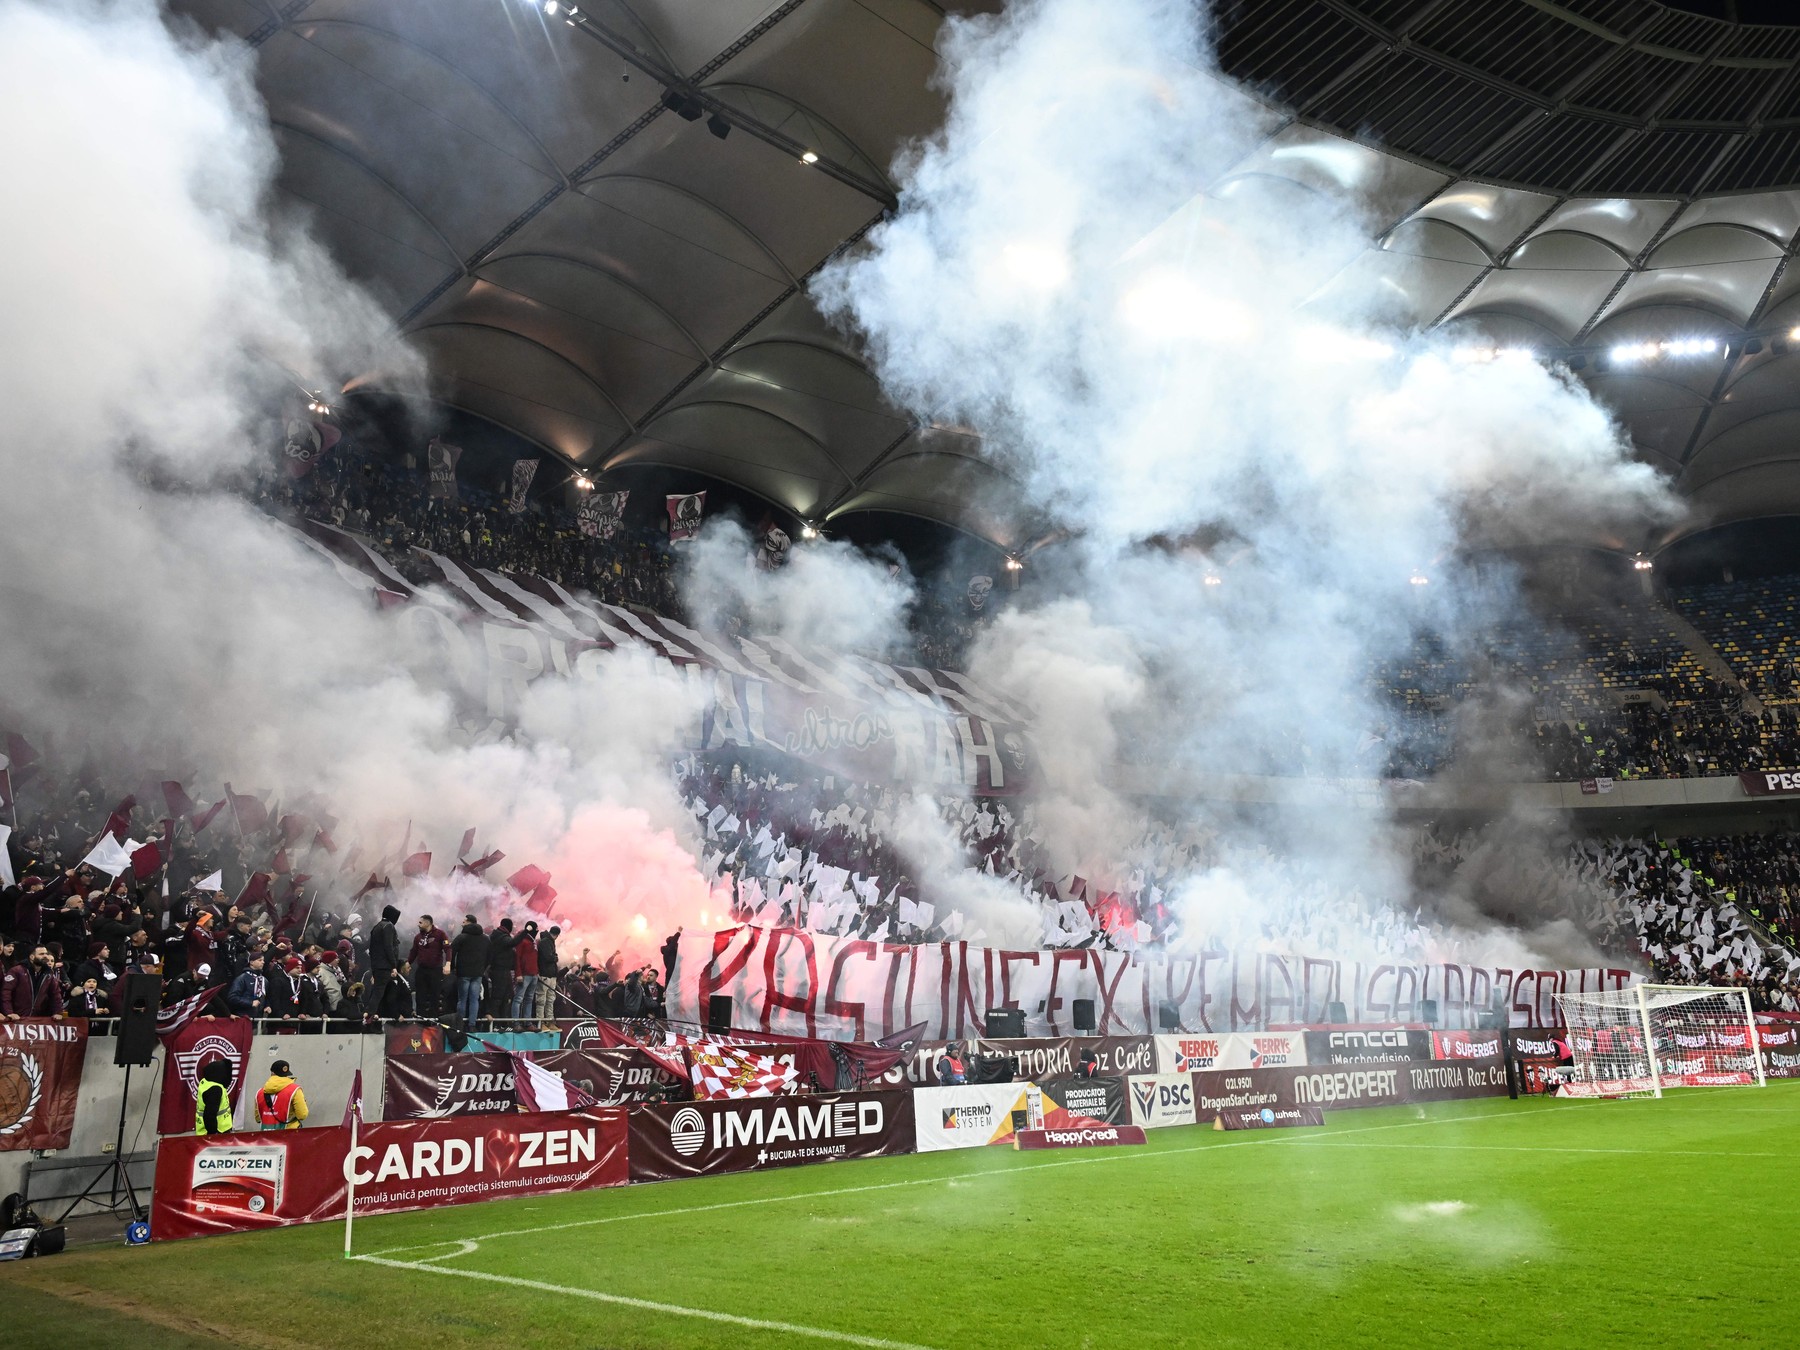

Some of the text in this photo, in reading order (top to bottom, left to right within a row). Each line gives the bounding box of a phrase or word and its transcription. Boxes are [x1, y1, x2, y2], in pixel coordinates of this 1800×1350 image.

[4, 1024, 78, 1045] VIȘINIE
[1718, 1032, 1746, 1047] SUPERBET
[1762, 1031, 1790, 1045] SUPERBET
[1456, 1039, 1498, 1058] SUPERBET
[1516, 1037, 1556, 1055] SUPERLIG
[1114, 1043, 1151, 1071] Café
[1188, 1053, 1287, 1069] pizza pizza
[1666, 1056, 1707, 1076] SUPERBET
[1723, 1053, 1757, 1070] SUPERBE
[1410, 1066, 1464, 1091] TRATTORIA
[1467, 1066, 1487, 1087] Roz
[1696, 1073, 1741, 1084] SUPERBET
[1769, 1068, 1789, 1077] Café
[1159, 1083, 1191, 1107] DSC
[1294, 1069, 1399, 1104] MOBEXPERT
[467, 1098, 511, 1112] kebap
[1067, 1097, 1107, 1109] MATERIALE DE
[1201, 1091, 1278, 1112] DragonStarCurier.ro
[712, 1100, 884, 1149] IMAMED
[956, 1116, 993, 1129] SYSTEM
[1240, 1112, 1261, 1122] spot
[1275, 1109, 1302, 1119] wheel
[1045, 1128, 1119, 1143] HappyCredit
[770, 1145, 846, 1161] BUCURA-TE DE SANATATE
[353, 1171, 590, 1206] ormulă unică pentru protecția sistemului cardiovascular
